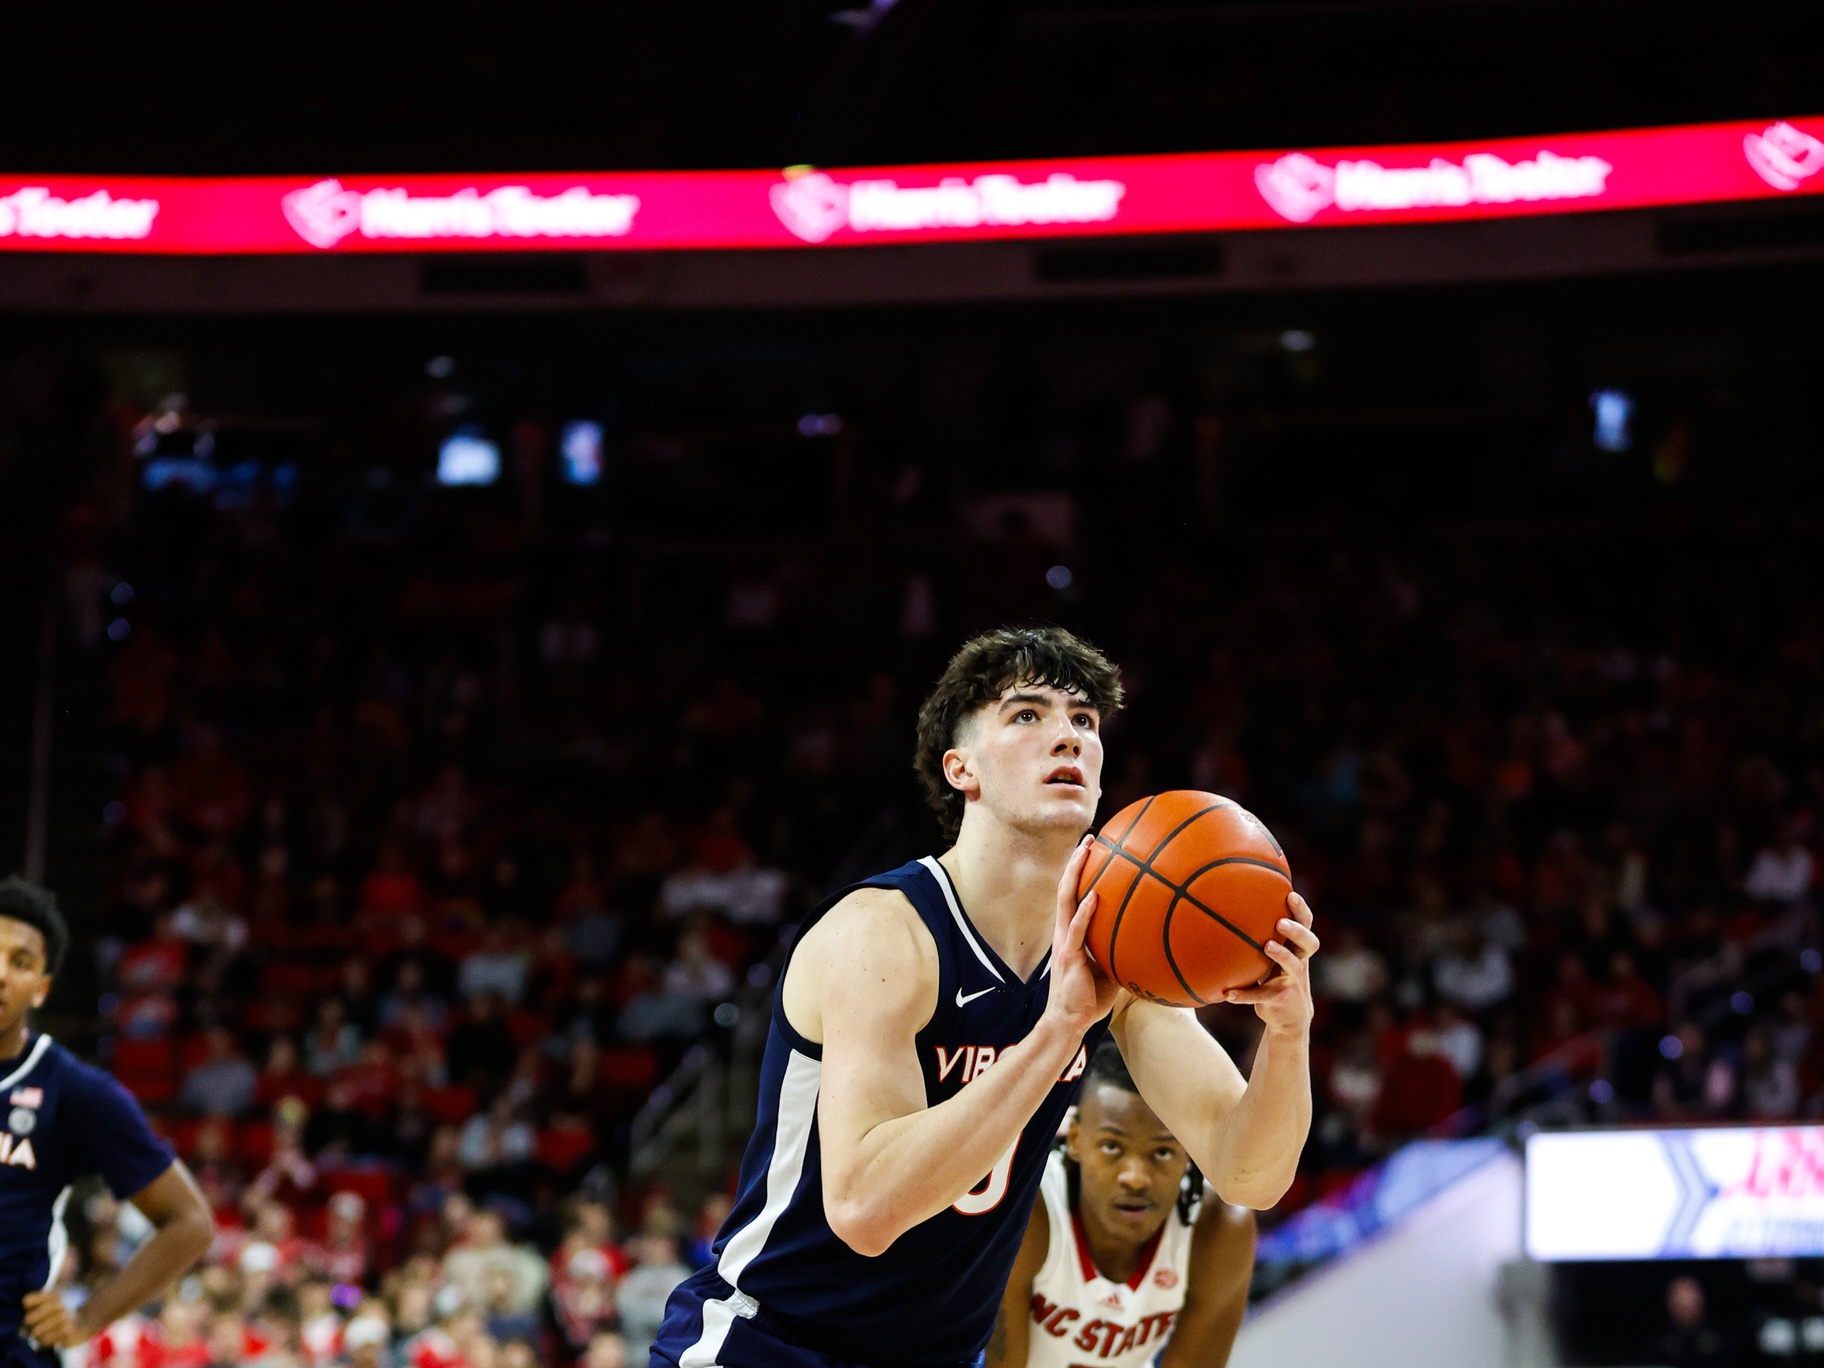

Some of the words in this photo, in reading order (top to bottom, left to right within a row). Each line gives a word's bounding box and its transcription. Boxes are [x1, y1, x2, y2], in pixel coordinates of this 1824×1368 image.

[935, 1043, 1087, 1083] VIRA
[1030, 1292, 1080, 1337] NC
[1073, 1311, 1177, 1358] STATE
